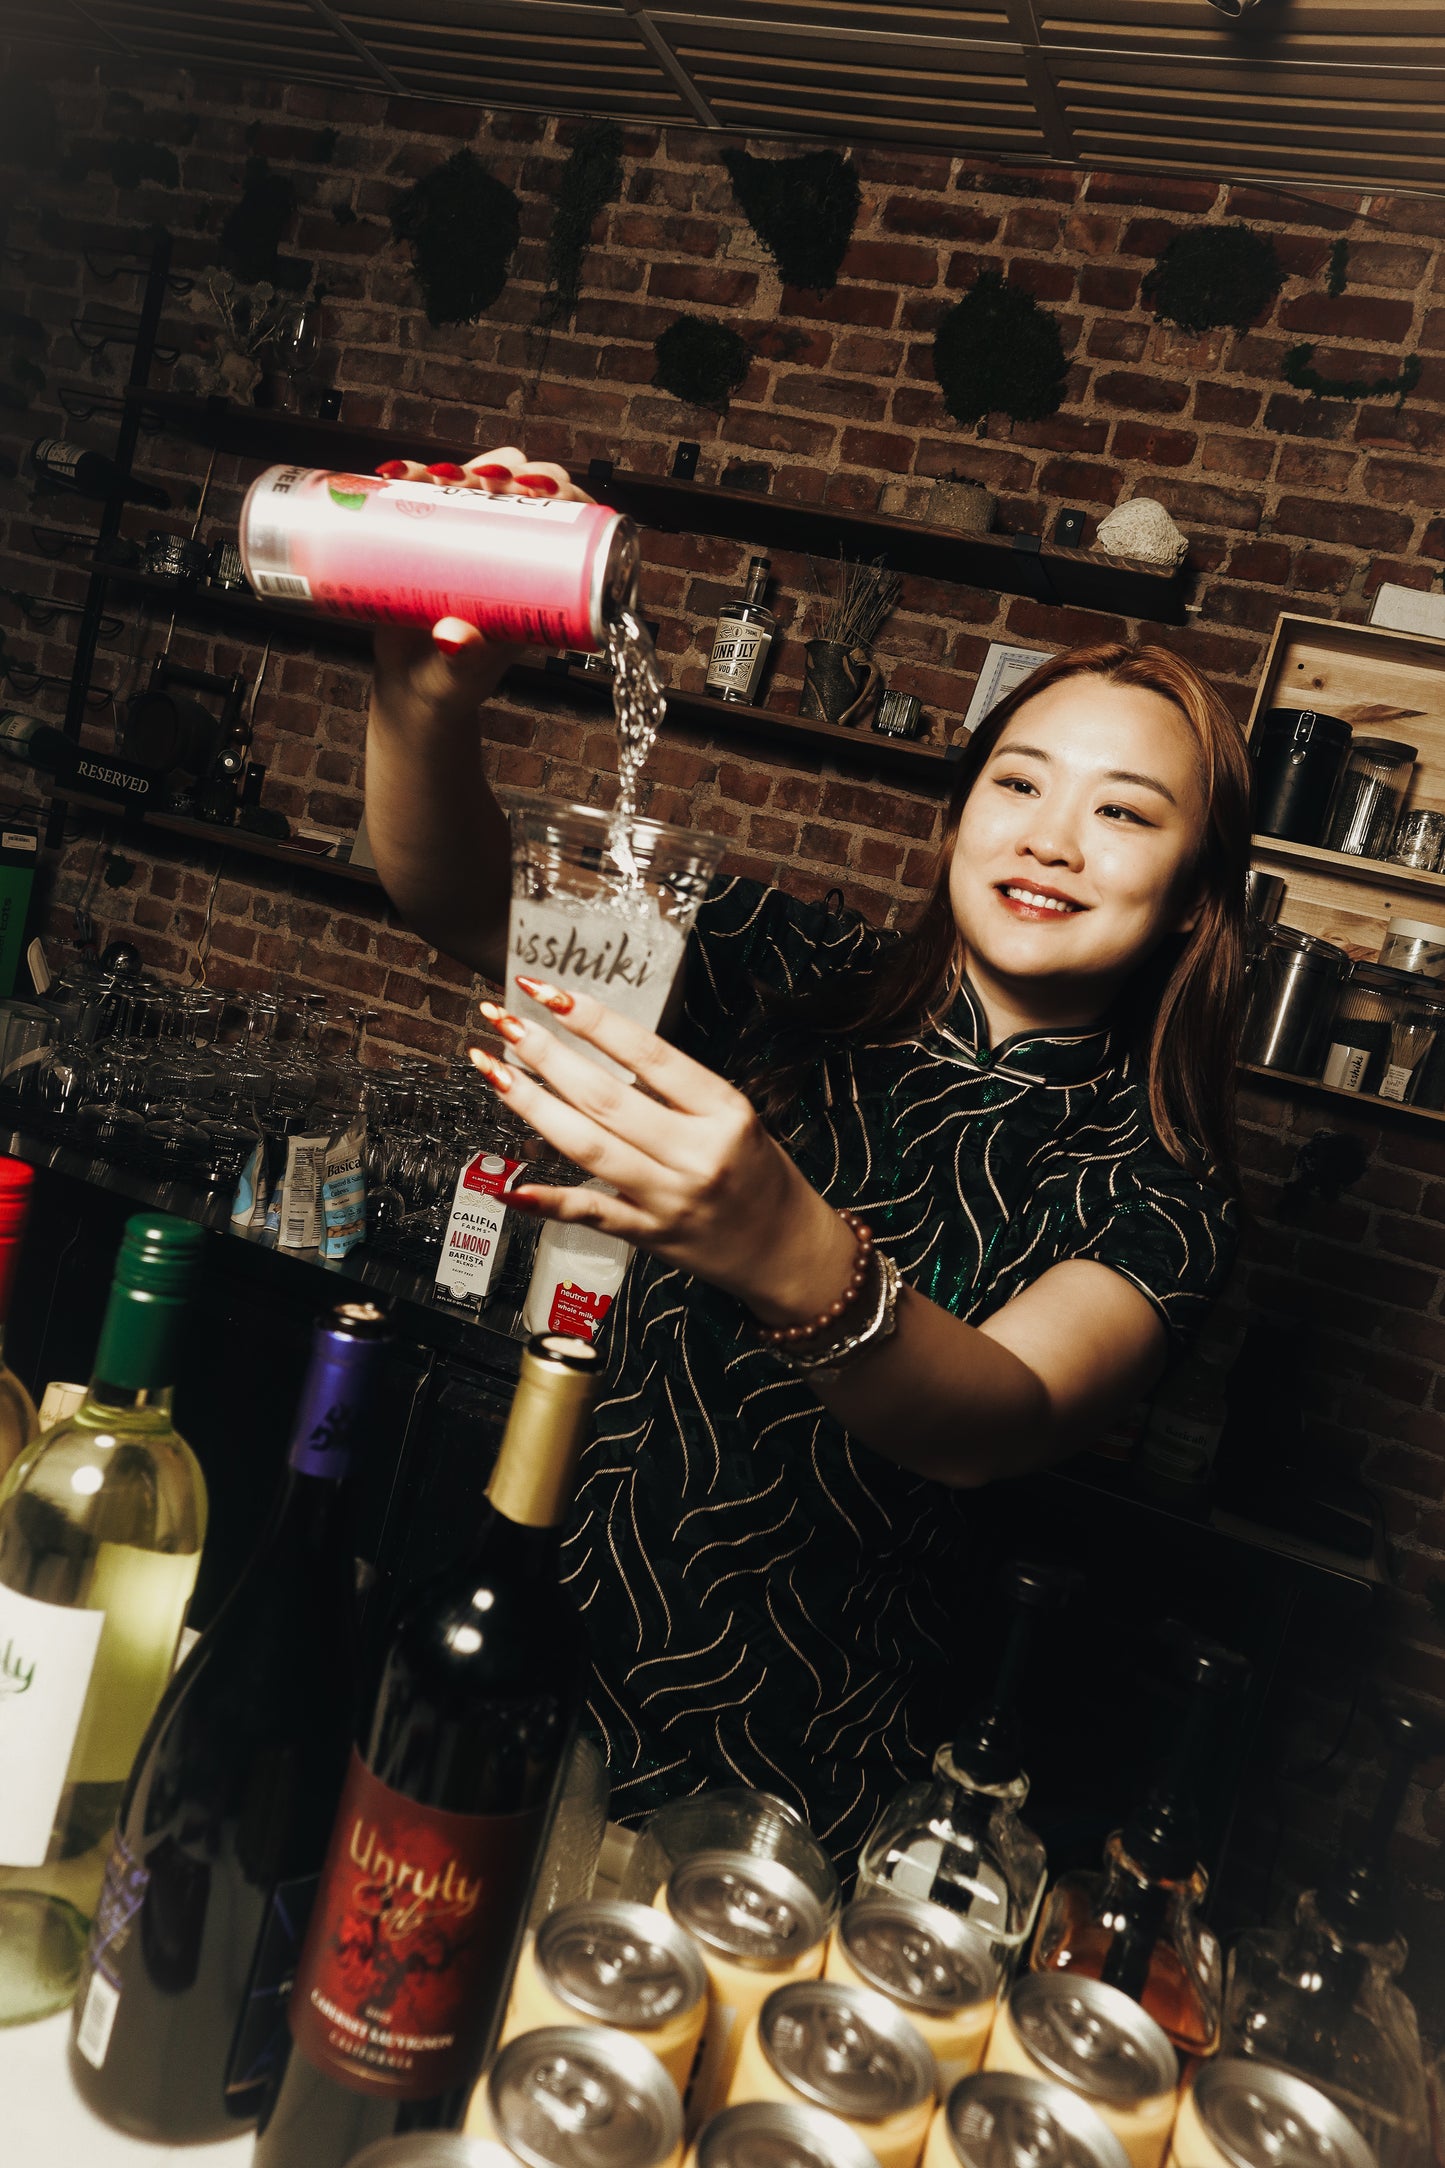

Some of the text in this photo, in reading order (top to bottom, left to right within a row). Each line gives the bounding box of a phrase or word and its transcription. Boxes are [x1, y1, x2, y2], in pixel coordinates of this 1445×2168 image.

[718, 664, 739, 676] VODA
[77, 760, 149, 794] RESERVED
[515, 918, 657, 988] isshiki
[1346, 1055, 1364, 1087] isshiki
[452, 1211, 498, 1232] CALIFIA
[461, 1222, 487, 1234] FARMS
[449, 1230, 491, 1257] ALMOND
[448, 1251, 484, 1267] BARISTA
[560, 1288, 588, 1304] neutral
[557, 1303, 577, 1315] whole
[578, 1310, 594, 1320] milk
